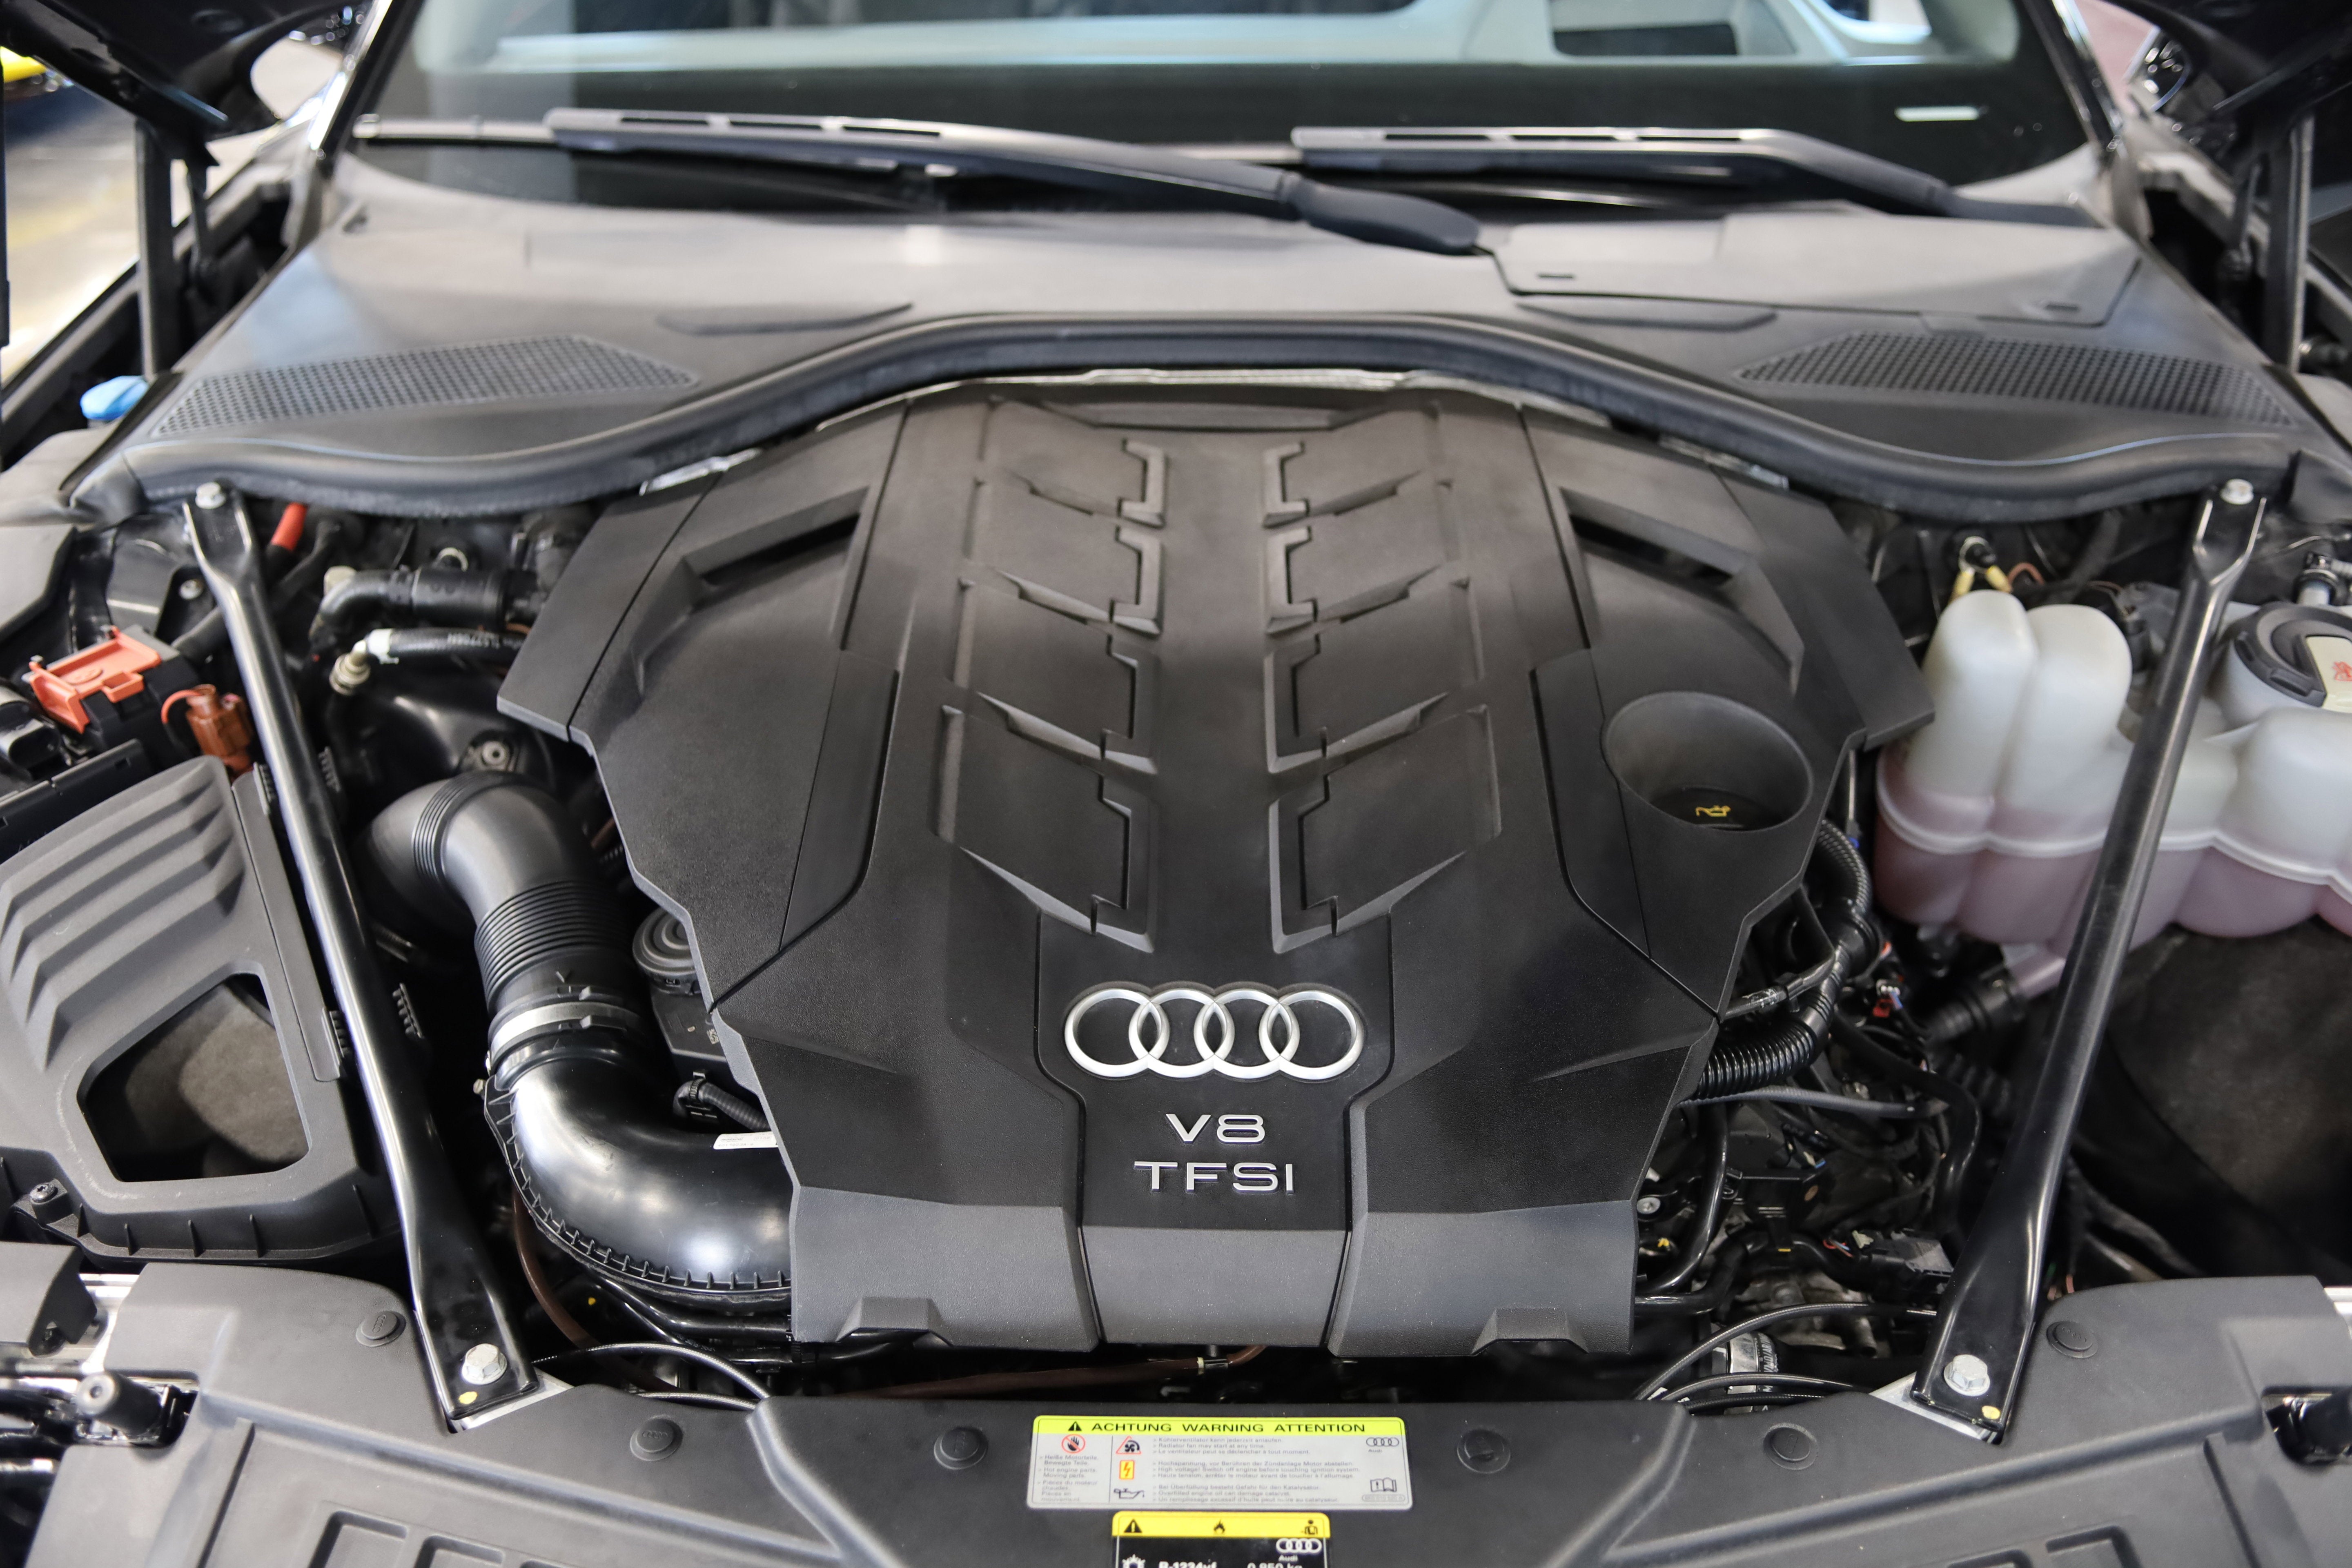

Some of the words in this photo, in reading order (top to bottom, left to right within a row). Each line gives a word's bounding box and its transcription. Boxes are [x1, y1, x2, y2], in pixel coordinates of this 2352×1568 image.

[1165, 1113, 1266, 1145] V8
[1134, 1161, 1296, 1194] TFSI
[1091, 1423, 1172, 1432] ACHTUNG
[1183, 1423, 1264, 1432] WARNING
[1274, 1424, 1365, 1432] ATTENTION
